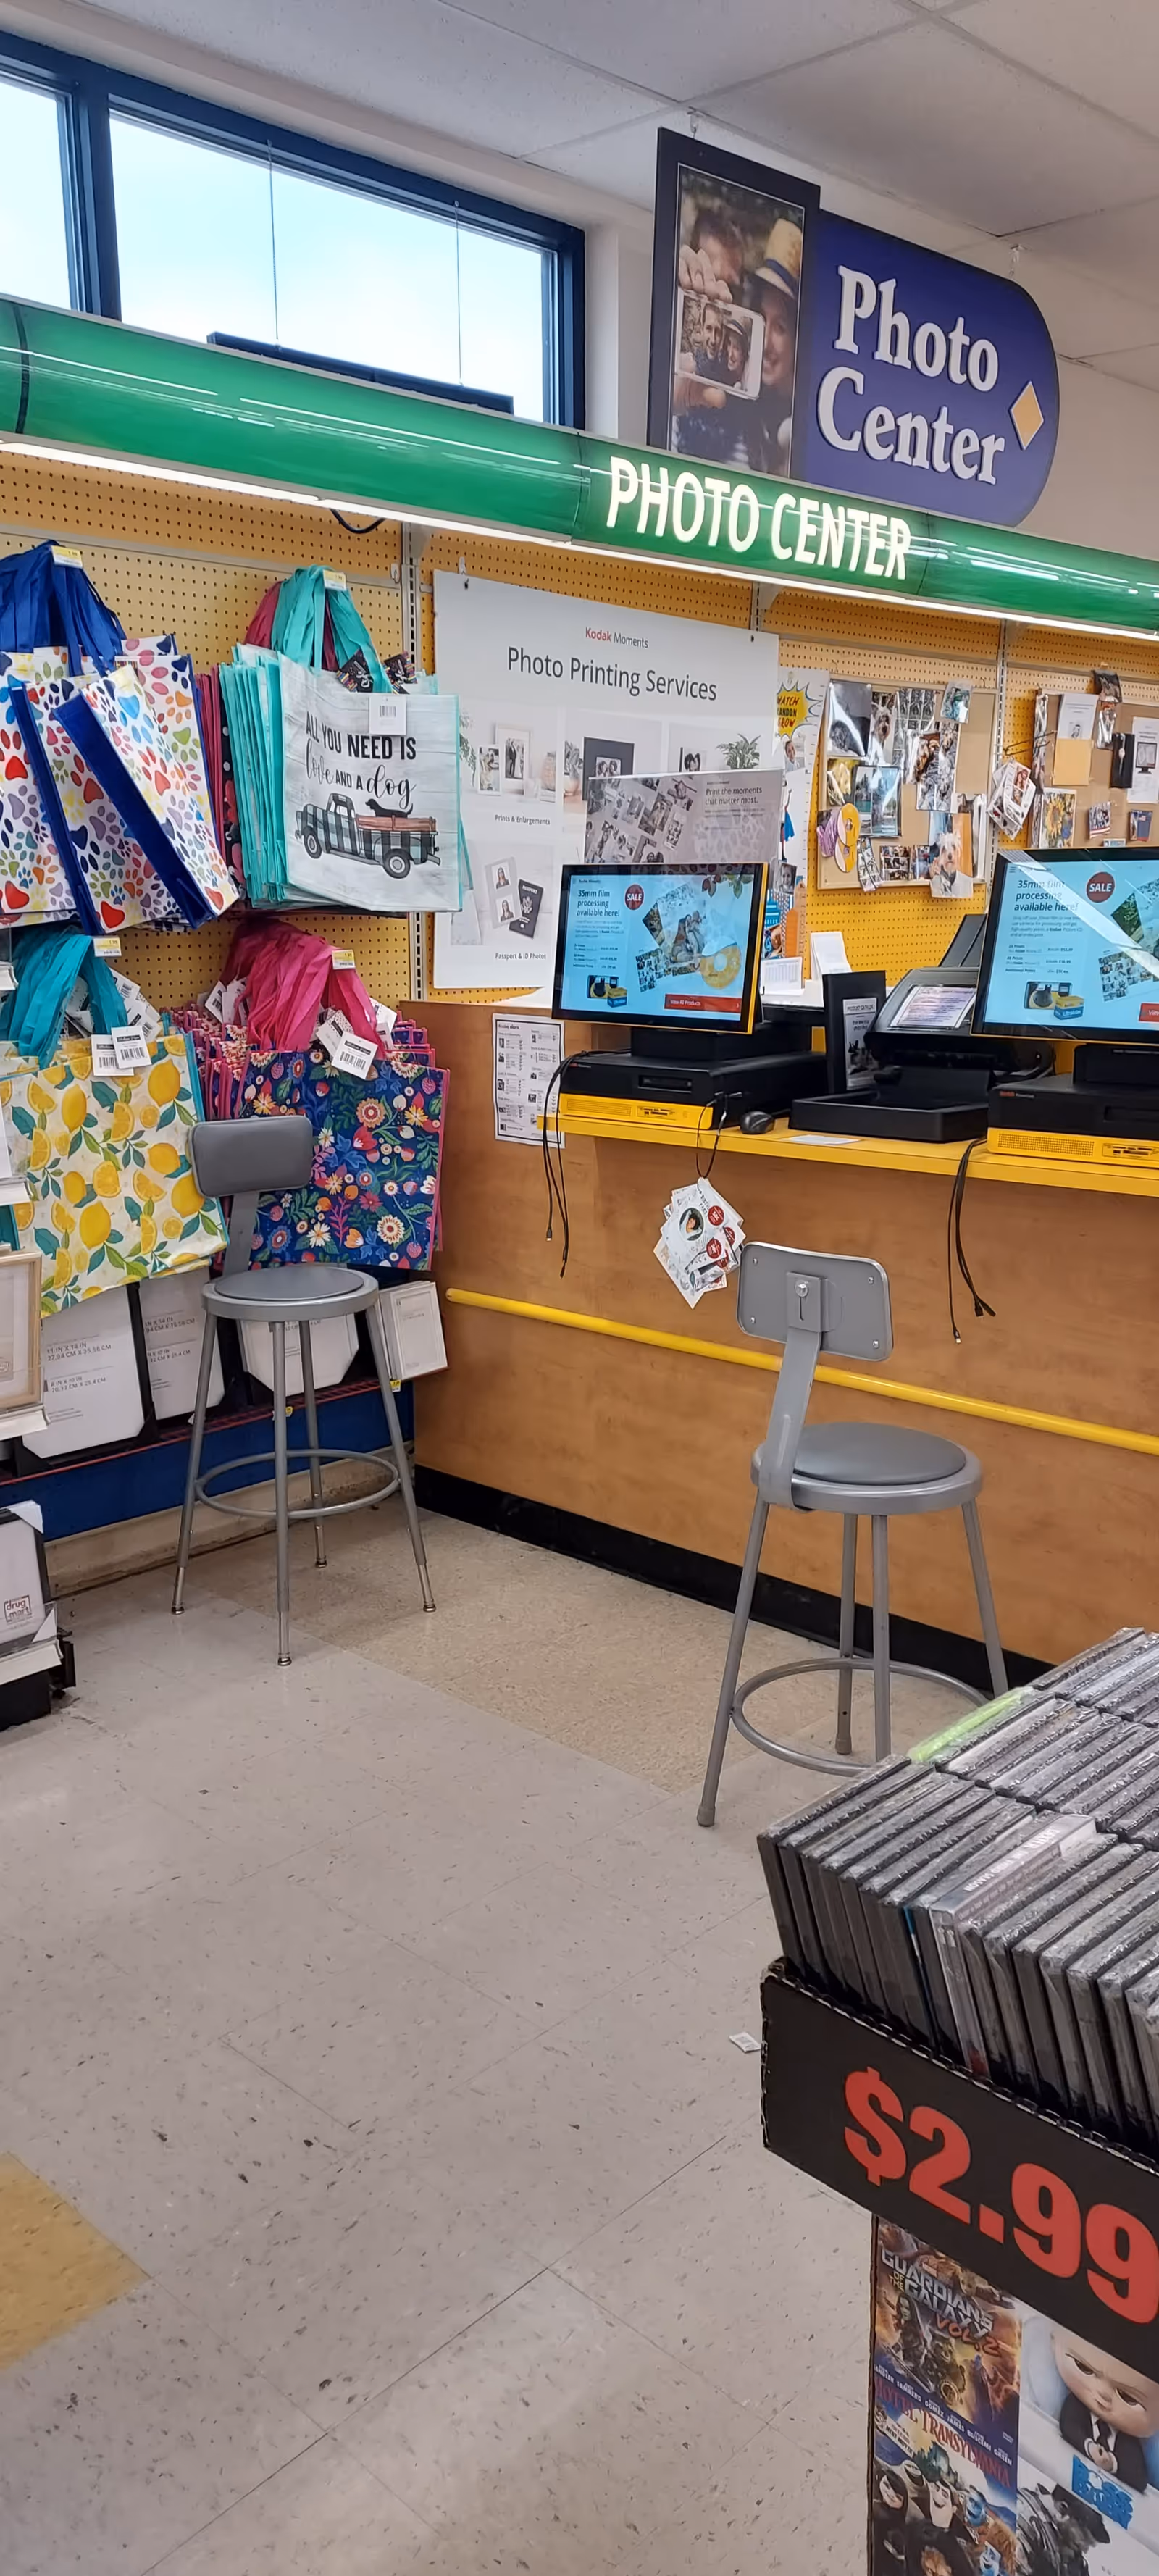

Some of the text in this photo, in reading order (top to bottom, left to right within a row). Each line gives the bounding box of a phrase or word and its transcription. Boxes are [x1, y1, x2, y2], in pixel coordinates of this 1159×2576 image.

[833, 264, 999, 393] Photo
[817, 366, 1007, 485] Center
[606, 456, 913, 581] PHOTO CENTER
[585, 627, 649, 649] Kodak Moments
[508, 646, 717, 701] Photo Printing Services
[306, 711, 417, 761] ALL YOU NEED IS
[306, 738, 417, 809] love AND A dog
[516, 816, 551, 826] Enlargements
[1017, 879, 1066, 890] 35mm film
[1089, 882, 1112, 892] SALE
[577, 899, 609, 908] processing
[627, 893, 643, 902] SALE
[1016, 892, 1063, 903] processing
[577, 908, 603, 916] available
[1014, 902, 1079, 911] available here!
[495, 953, 517, 962] Passport
[6, 1599, 26, 1611] drug
[9, 1607, 30, 1619] mart
[844, 2066, 1159, 2325] $2.99
[889, 2275, 905, 2292] THE
[894, 2272, 905, 2283] OF
[882, 2248, 994, 2331] GUARDIANS
[905, 2278, 989, 2338] GALAXY
[875, 2365, 895, 2383] ANDLER
[925, 2399, 945, 2419] GOMEZ
[967, 2429, 992, 2451] BUSCEMI
[994, 2449, 1013, 2466] GREEN
